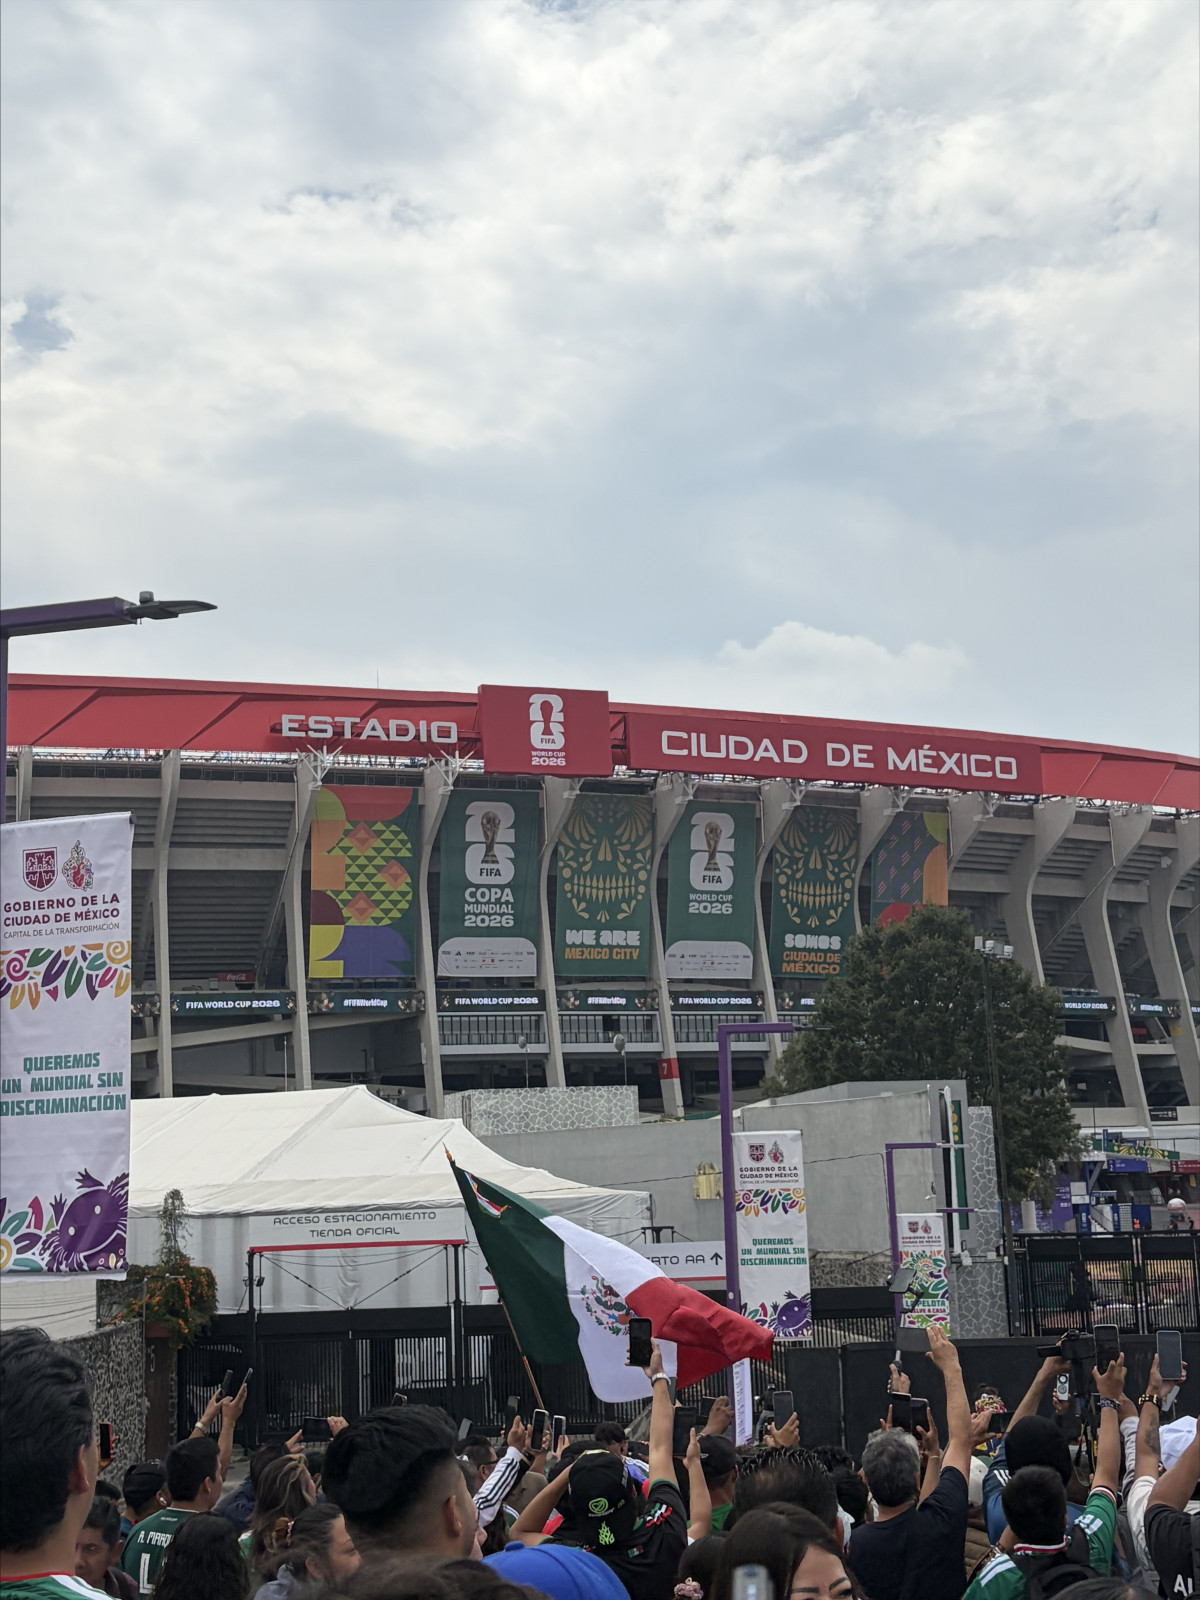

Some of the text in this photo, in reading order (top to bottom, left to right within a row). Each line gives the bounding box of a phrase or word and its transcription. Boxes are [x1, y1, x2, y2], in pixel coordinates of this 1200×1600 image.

[281, 714, 458, 744] ESTADIO
[661, 730, 1018, 780] CIUDAD DE MÉXICO
[532, 757, 566, 766] 2026
[480, 868, 502, 877] FIFA
[702, 875, 722, 884] FIFA
[464, 888, 514, 902] COPA
[689, 893, 733, 902] WORLD CUP
[4, 894, 120, 913] GOBIERNO DE LA
[464, 904, 514, 913] MUNDIAL
[688, 903, 733, 915] 2026
[4, 908, 120, 927] CIUDAD DE MÉXICO
[464, 915, 514, 927] 2026
[4, 931, 31, 939] CAPITAL
[56, 922, 119, 935] TRANSFORMACIÓN
[566, 930, 596, 945] WE
[784, 934, 841, 950] SOMOS
[564, 948, 639, 960] MEXICO CITY
[783, 951, 840, 963] CIUDAD DE
[782, 962, 840, 974] MÉXICO
[186, 1001, 204, 1009] FIFA
[24, 1052, 100, 1074] QUEREMOS
[662, 1063, 667, 1075] 7
[2, 1072, 123, 1094] UN MUNDIAL SIN
[0, 1092, 126, 1116] DISCRIMINACIÓN
[273, 1212, 436, 1225] ACCESO ESTACIONAMIENTO
[309, 1227, 400, 1238] TIENDA OFICIAL
[752, 1238, 794, 1246] QUEREMOS
[645, 1255, 705, 1266] RTO AA
